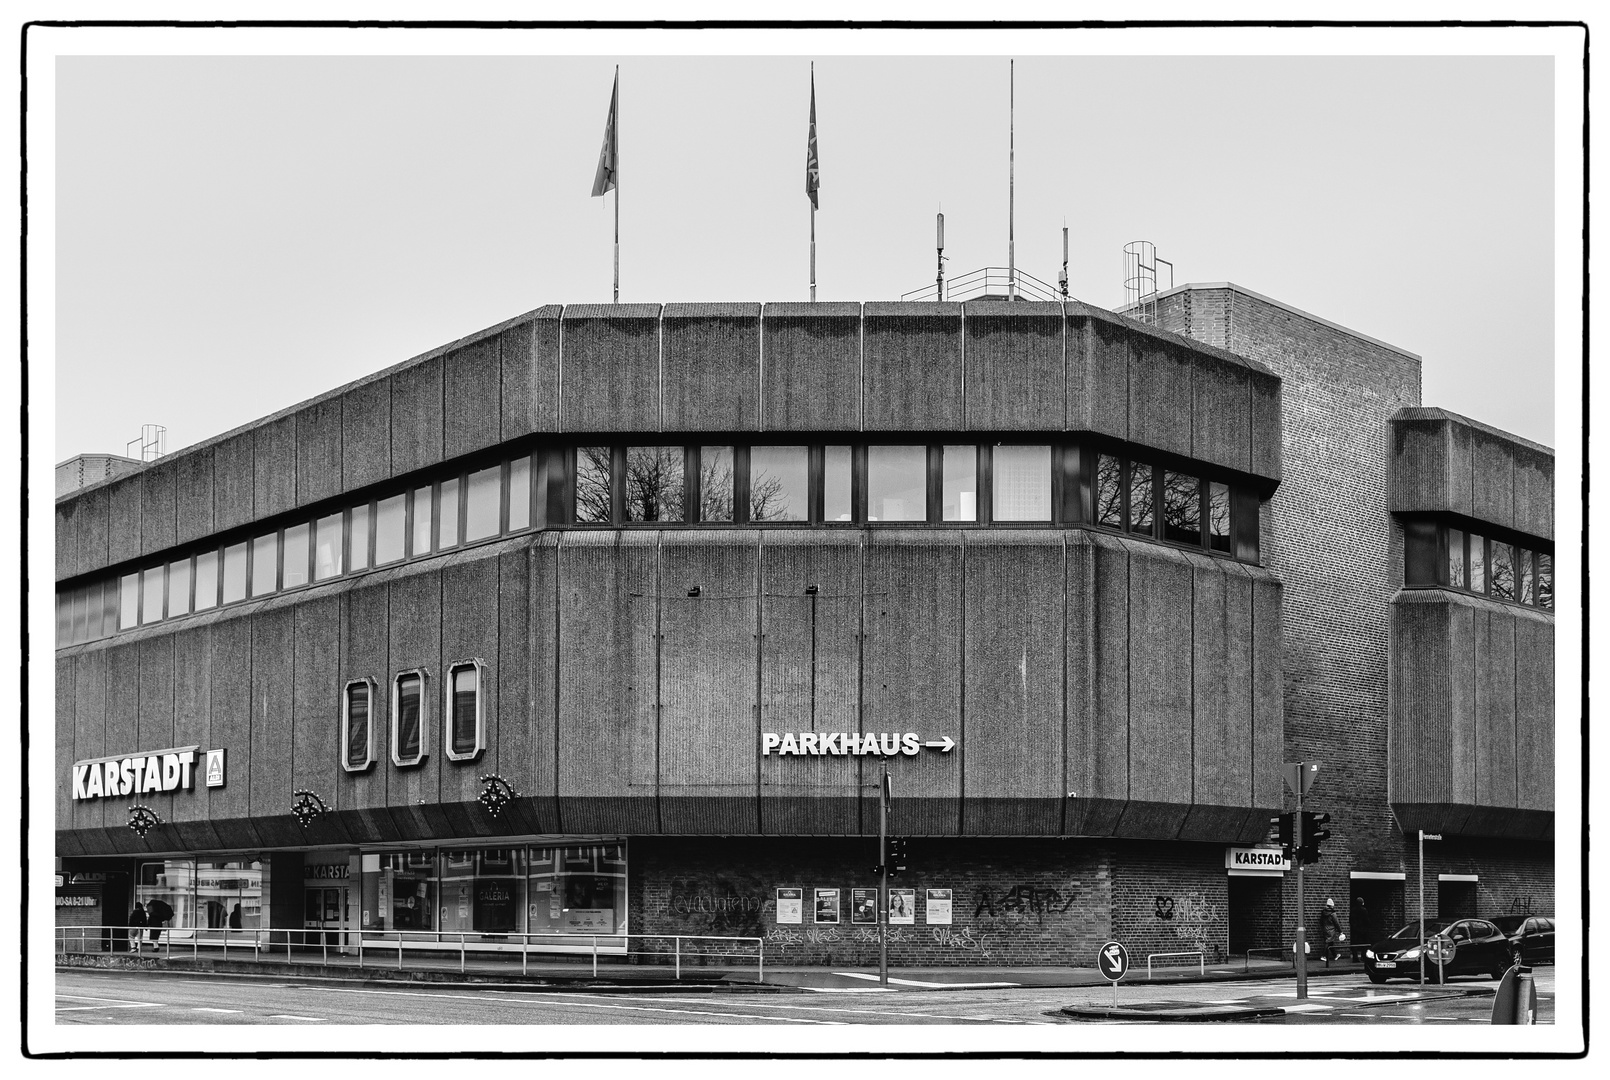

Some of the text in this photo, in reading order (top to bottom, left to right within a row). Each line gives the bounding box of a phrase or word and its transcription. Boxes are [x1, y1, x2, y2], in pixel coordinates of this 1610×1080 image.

[763, 732, 920, 755] PARKHAUS
[72, 752, 194, 799] KARSTADT
[479, 891, 510, 901] GALERIA
